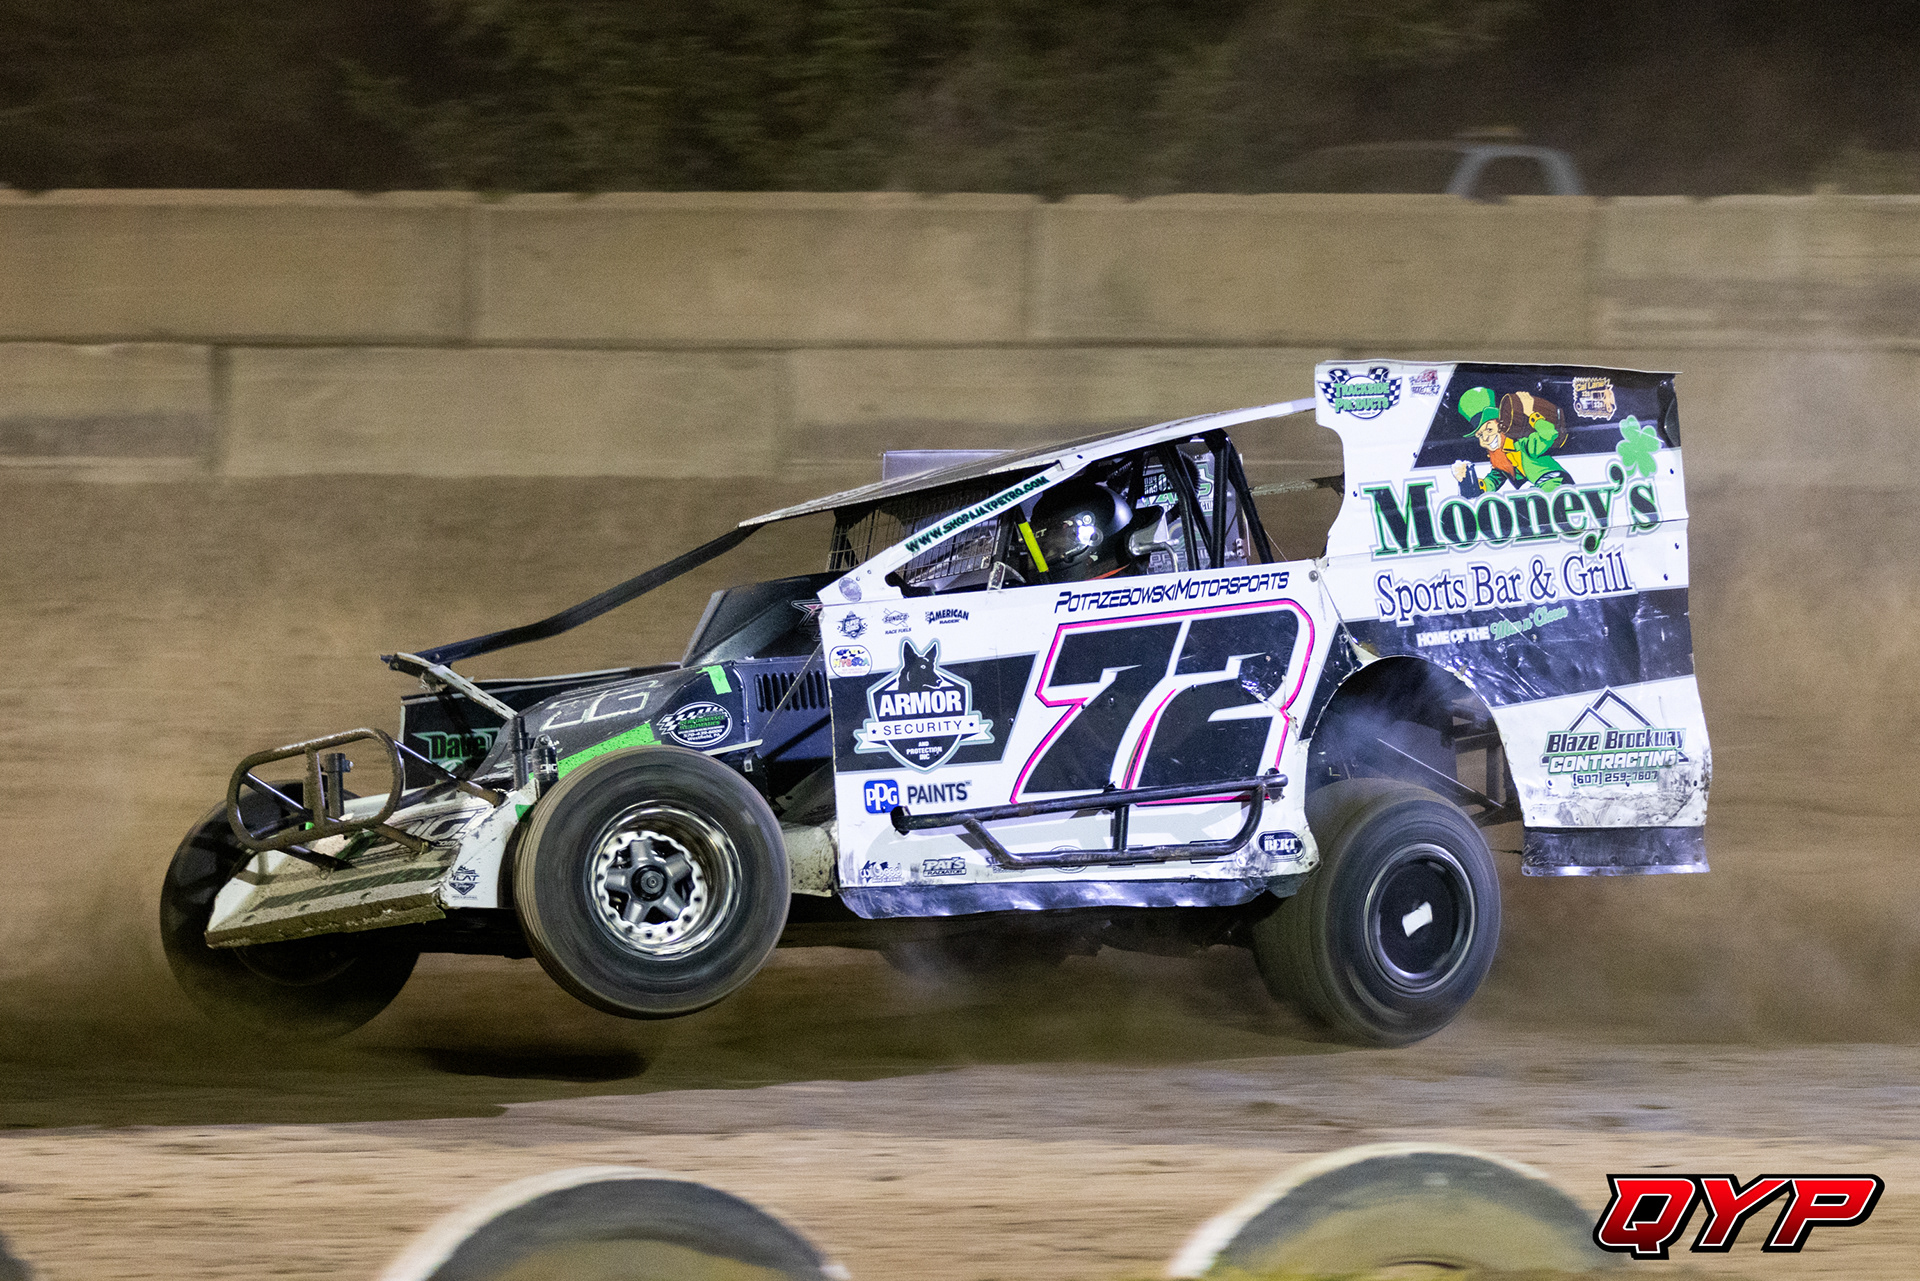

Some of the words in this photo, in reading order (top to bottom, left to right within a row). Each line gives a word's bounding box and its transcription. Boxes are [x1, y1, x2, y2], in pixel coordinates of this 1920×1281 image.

[1334, 382, 1390, 398] TRACKSIDE
[1335, 397, 1390, 413] PRODUCTS
[1363, 464, 1660, 555] Mooney's
[1376, 573, 1467, 622] Sports
[1471, 565, 1521, 606] Bar
[1530, 559, 1556, 601] &
[1563, 551, 1633, 596] Grill
[928, 609, 969, 625] AMERICAN
[1416, 630, 1450, 647] HOME
[1450, 628, 1466, 644] OF
[1466, 626, 1490, 642] THE
[879, 690, 962, 717] ARMOR
[1014, 602, 1312, 804] 72
[883, 720, 962, 736] SECURITY
[906, 746, 943, 755] PROTECTION
[1546, 733, 1600, 753] Blaze
[1605, 730, 1685, 750] Brockway
[1549, 750, 1677, 773] CONTRACTING
[1605, 770, 1658, 783] 259-7607
[865, 783, 898, 811] PPG
[923, 857, 966, 870] PAT'S
